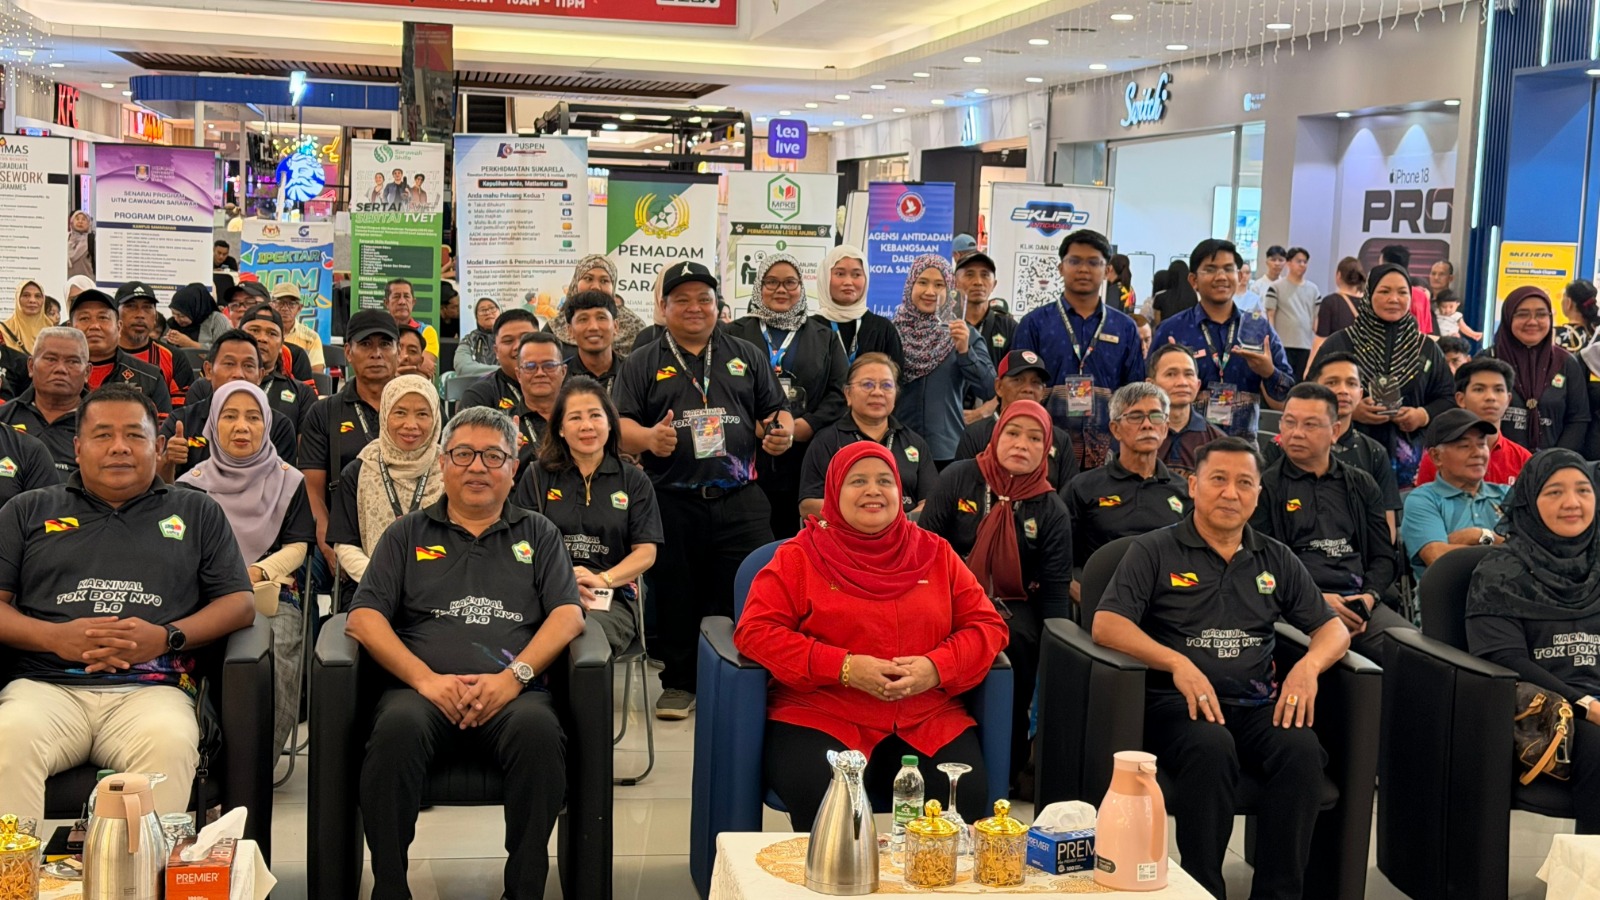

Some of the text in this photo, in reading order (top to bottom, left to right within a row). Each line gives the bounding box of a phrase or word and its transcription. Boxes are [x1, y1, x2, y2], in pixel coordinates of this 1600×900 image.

[58, 83, 80, 129] KFC
[776, 124, 800, 138] tea
[776, 140, 800, 154] live
[1394, 168, 1420, 184] iPhone
[356, 203, 401, 212] SERTAI
[1362, 188, 1454, 233] PRO
[114, 212, 194, 222] PROGRAM DIPLOMA
[404, 213, 436, 223] TVET
[868, 232, 952, 242] AGENSI ANTIDADAH
[618, 244, 704, 258] PEMADAM
[880, 244, 939, 252] KEBANGSAAN
[870, 265, 893, 273] KOTA
[77, 578, 144, 592] KARNIVAL
[57, 590, 162, 606] TOK BOK NYO
[450, 596, 503, 610] KARNIVAL
[94, 601, 123, 613] 3.0
[461, 606, 523, 622] BOK NYO
[465, 614, 490, 624] 3.0
[1186, 637, 1240, 648] TOK BOK
[1534, 644, 1597, 659] TOK BOK
[176, 873, 218, 884] PREMIER
